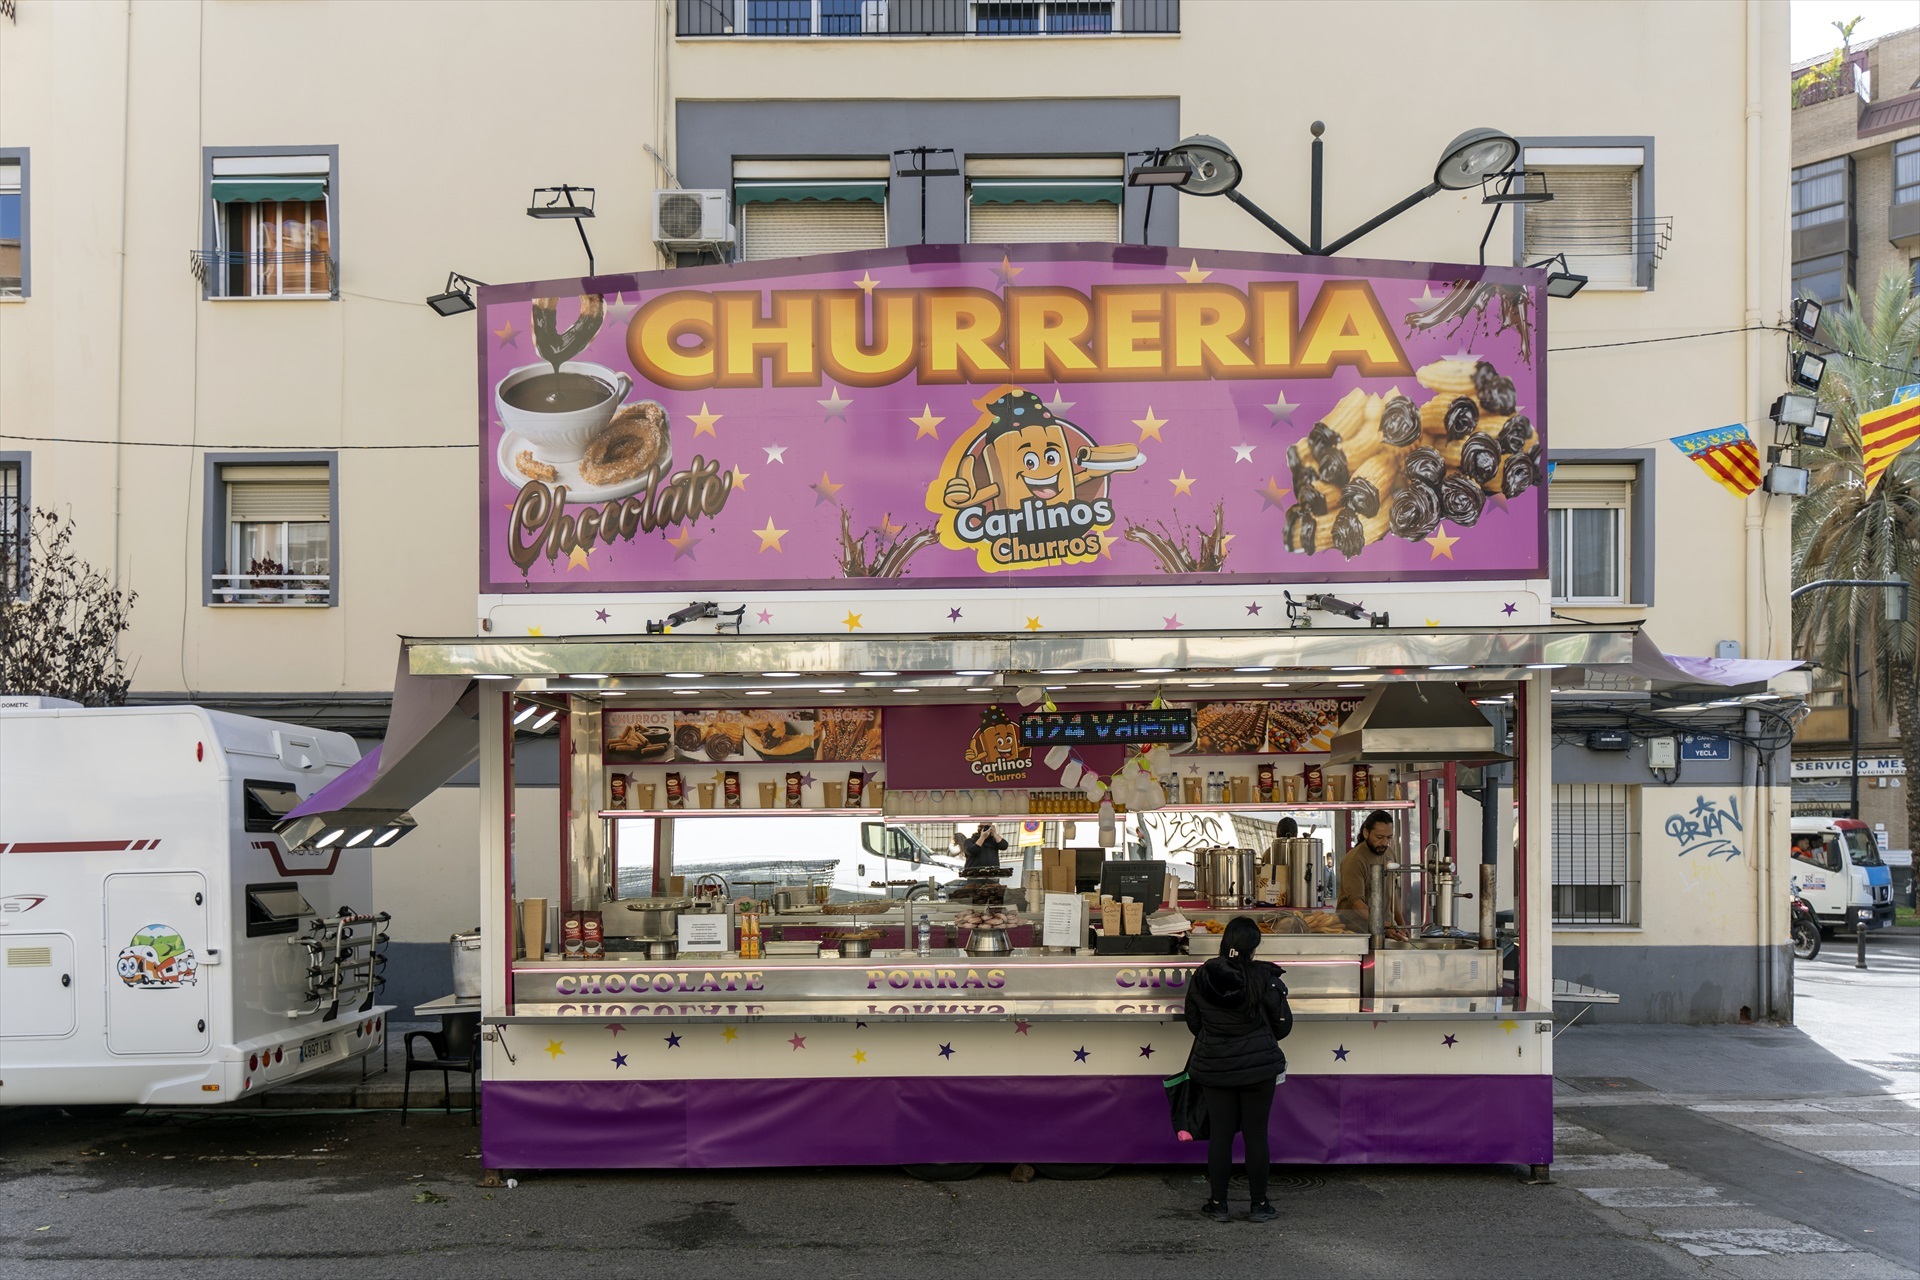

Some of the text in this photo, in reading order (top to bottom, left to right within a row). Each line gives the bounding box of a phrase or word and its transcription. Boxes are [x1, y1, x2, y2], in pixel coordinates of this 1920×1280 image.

[627, 280, 1415, 389] CHURRERIA
[508, 455, 733, 567] Chocolate
[956, 499, 1113, 541] Carlinos
[992, 535, 1100, 563] Churros
[821, 710, 875, 722] SABORES
[1269, 702, 1337, 713] DECORADOS
[608, 713, 668, 725] CHURROS
[752, 711, 801, 723] PORRAS
[971, 758, 1033, 775] Carlinos
[1795, 760, 1868, 771] SERVICO
[986, 772, 1027, 782] Churros
[555, 971, 765, 995] CHOCOLATE
[866, 969, 1006, 990] PORRAS
[1115, 968, 1196, 988] CHU
